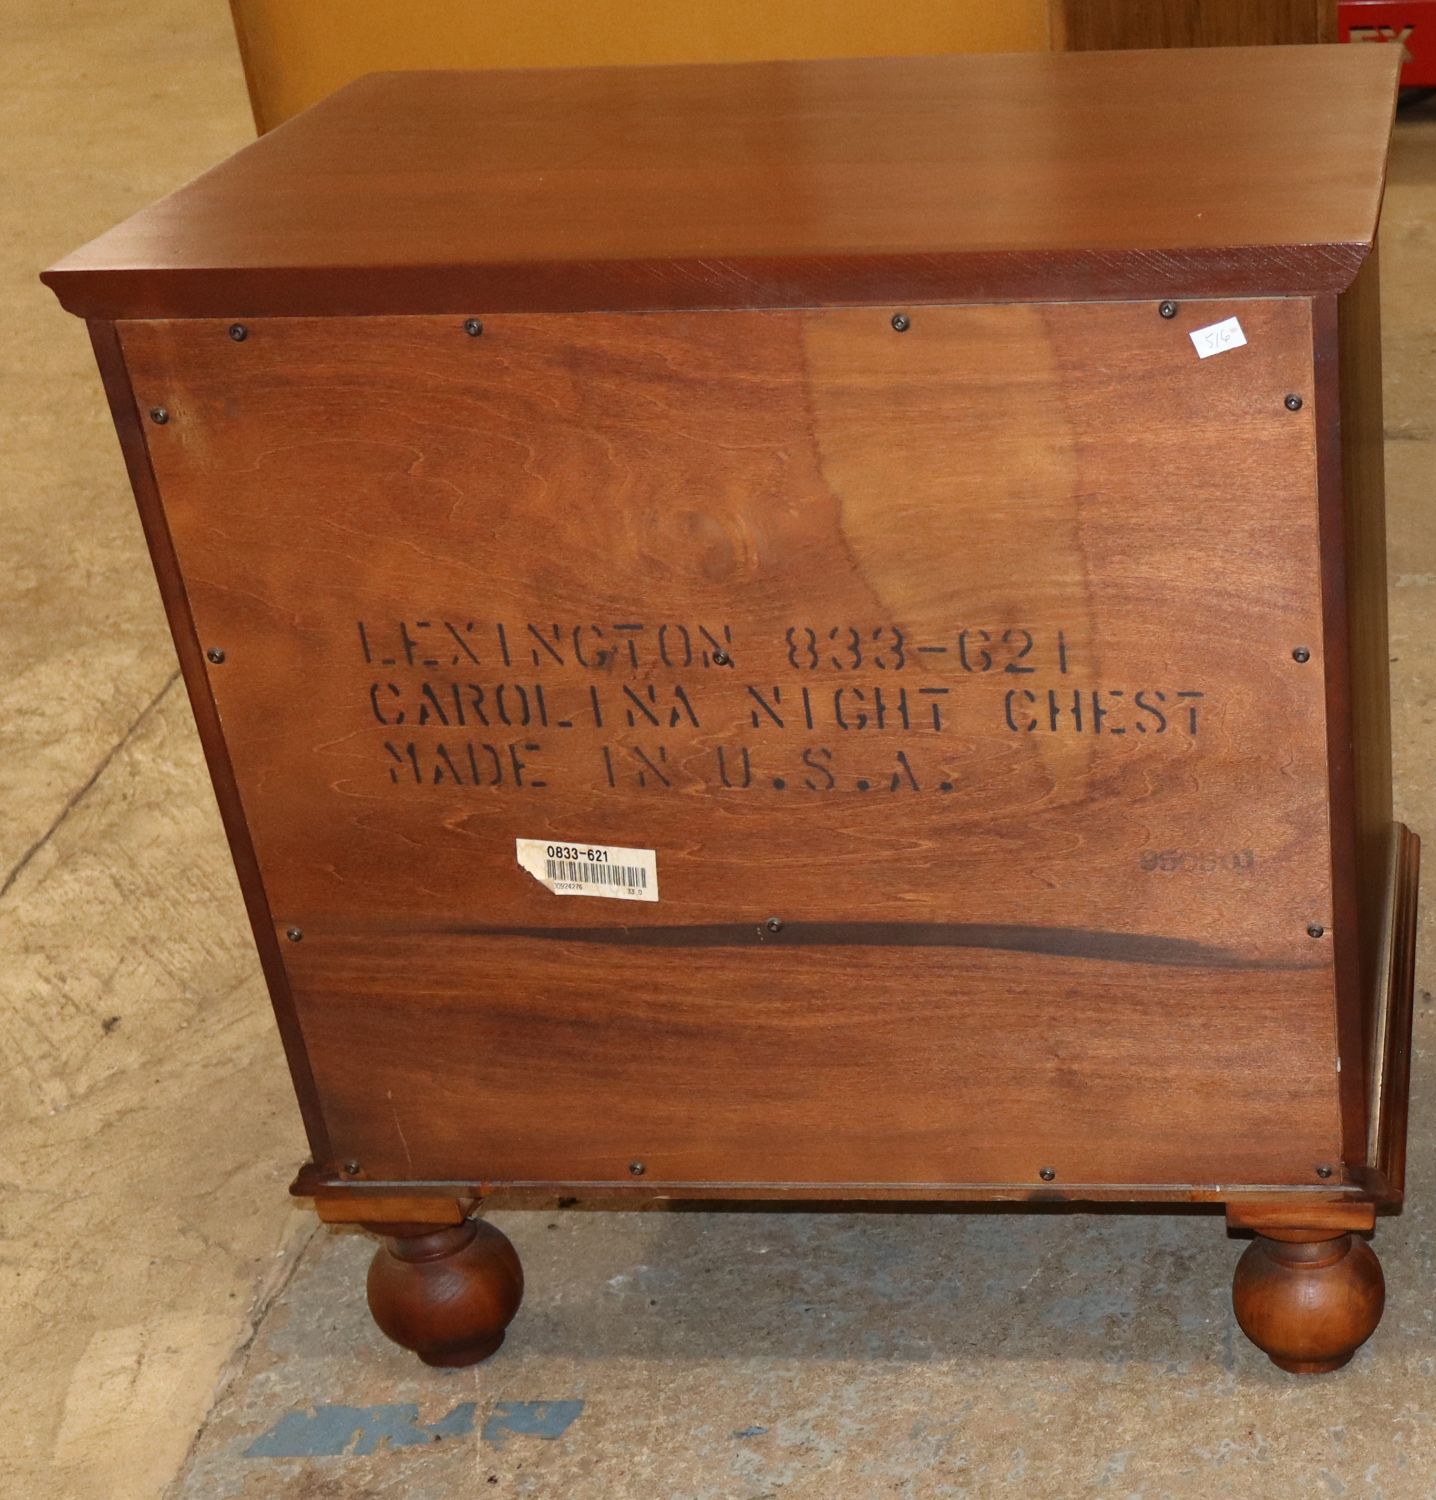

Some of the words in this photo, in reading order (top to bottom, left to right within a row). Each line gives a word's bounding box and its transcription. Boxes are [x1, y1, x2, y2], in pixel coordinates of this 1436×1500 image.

[358, 621, 735, 668] LEXINGTON
[786, 627, 1067, 674] 833-621
[370, 683, 700, 728] CAROLINA
[747, 685, 949, 731] NIGHT
[1005, 689, 1203, 734] CHEST
[384, 741, 546, 787] MADE
[604, 745, 671, 787] IN
[718, 747, 953, 792] U.S.A.
[547, 846, 608, 862] 0833-621
